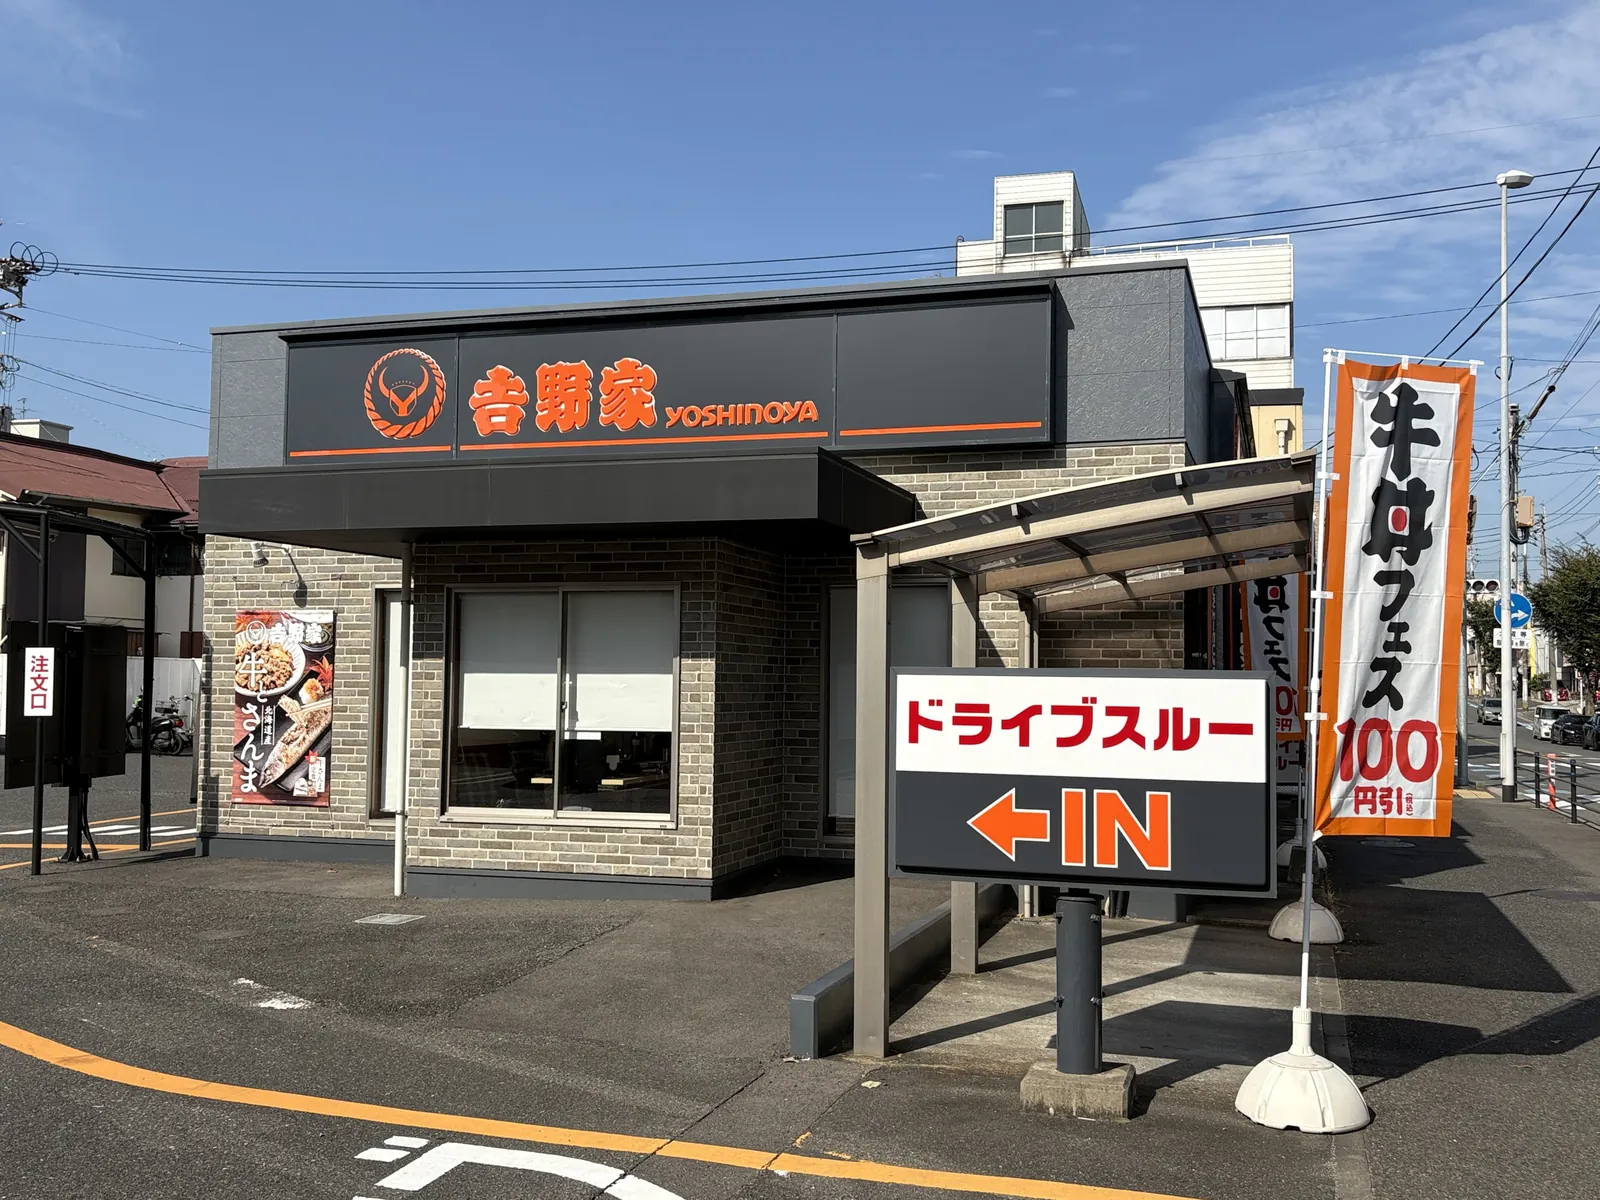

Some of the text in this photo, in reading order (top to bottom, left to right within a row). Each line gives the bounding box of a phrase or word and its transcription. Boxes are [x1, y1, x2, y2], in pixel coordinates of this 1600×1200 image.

[665, 400, 819, 430] YOSHINOYA
[1362, 380, 1442, 712] 牛丼フェス
[30, 655, 49, 711] 注文口
[263, 705, 274, 746] 北海道産
[908, 697, 1254, 752] ドライブスルー
[1336, 717, 1439, 783] 100
[1062, 788, 1172, 871] IN
